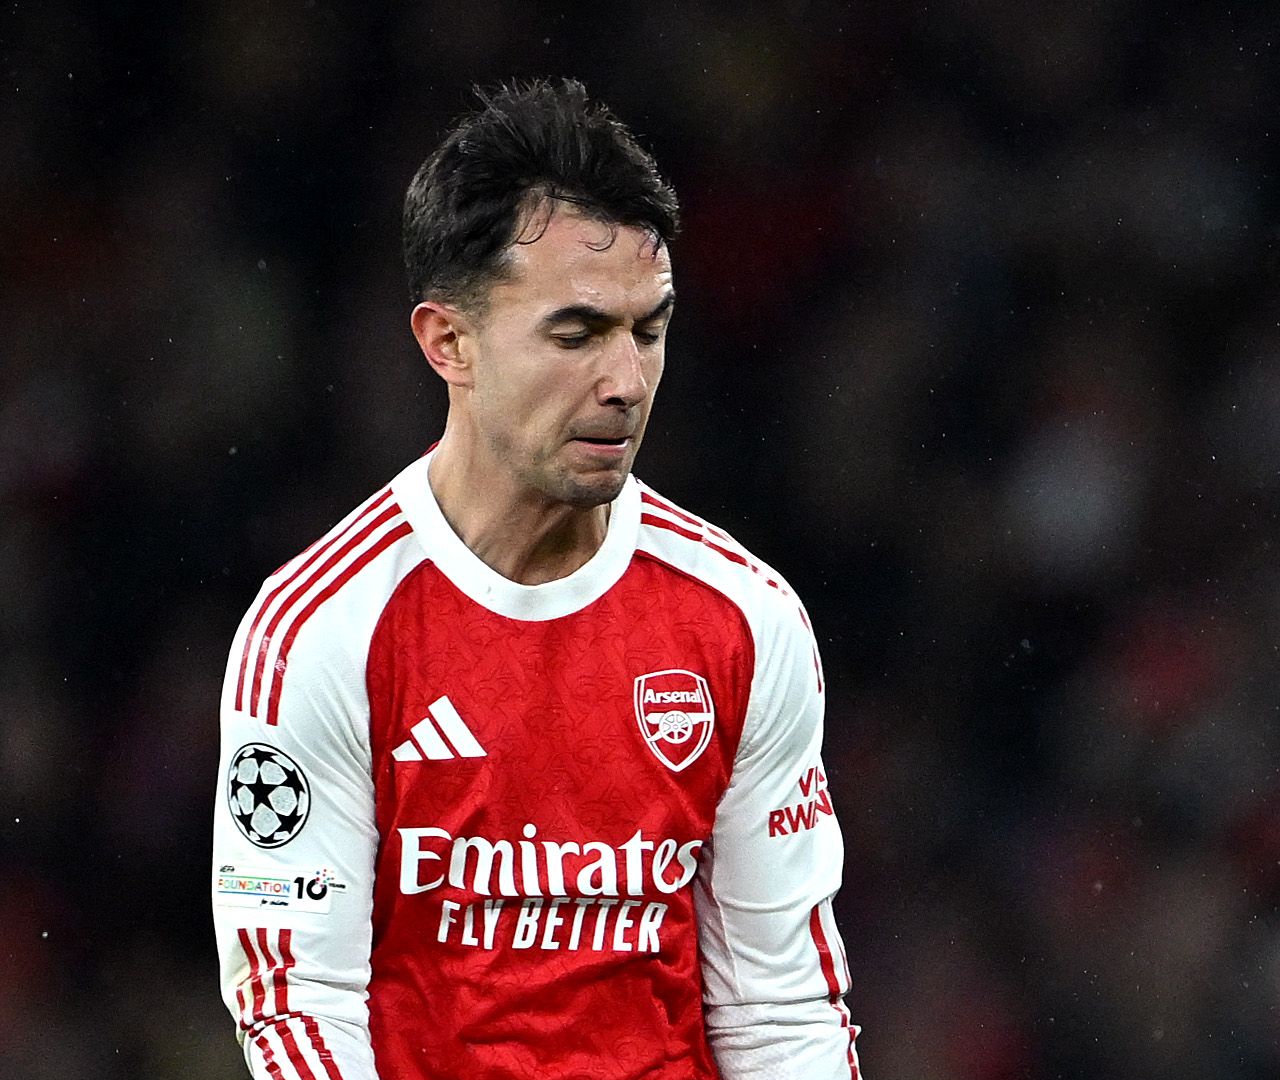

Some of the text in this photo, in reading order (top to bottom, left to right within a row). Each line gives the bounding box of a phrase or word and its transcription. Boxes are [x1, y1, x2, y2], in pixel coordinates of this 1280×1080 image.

[643, 688, 703, 704] Arsenal
[397, 822, 704, 897] Emirates
[218, 878, 291, 893] FOUNDATION
[293, 876, 328, 901] 10
[437, 897, 668, 953] FLY BETTER
